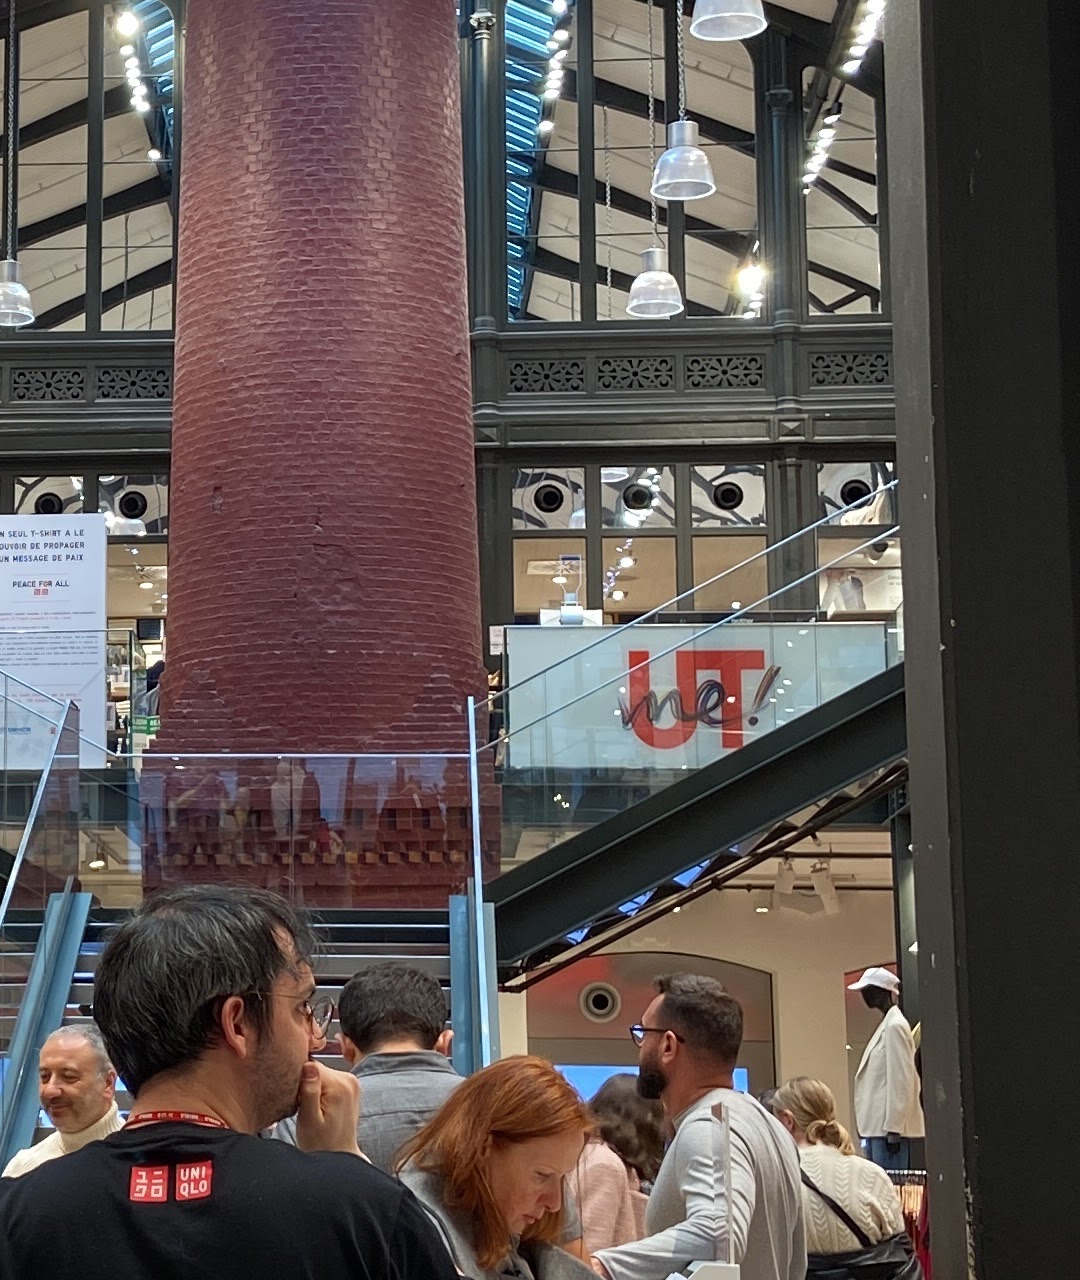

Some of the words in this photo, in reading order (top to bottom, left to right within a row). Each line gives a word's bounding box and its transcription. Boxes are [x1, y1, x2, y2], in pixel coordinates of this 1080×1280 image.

[8, 530, 28, 538] SEUL
[30, 530, 62, 538] T-SHIRT
[74, 529, 85, 537] LE
[30, 542, 41, 550] DE
[43, 541, 85, 550] PROPAGER
[12, 554, 49, 562] MESSAGE
[52, 554, 63, 562] DE
[65, 553, 84, 561] PAIX
[12, 580, 37, 588] PEACE
[38, 580, 53, 588] FOR
[55, 579, 70, 587] ALL
[628, 649, 766, 750] UT
[180, 1166, 206, 1181] UNI
[179, 1179, 208, 1198] QLO
